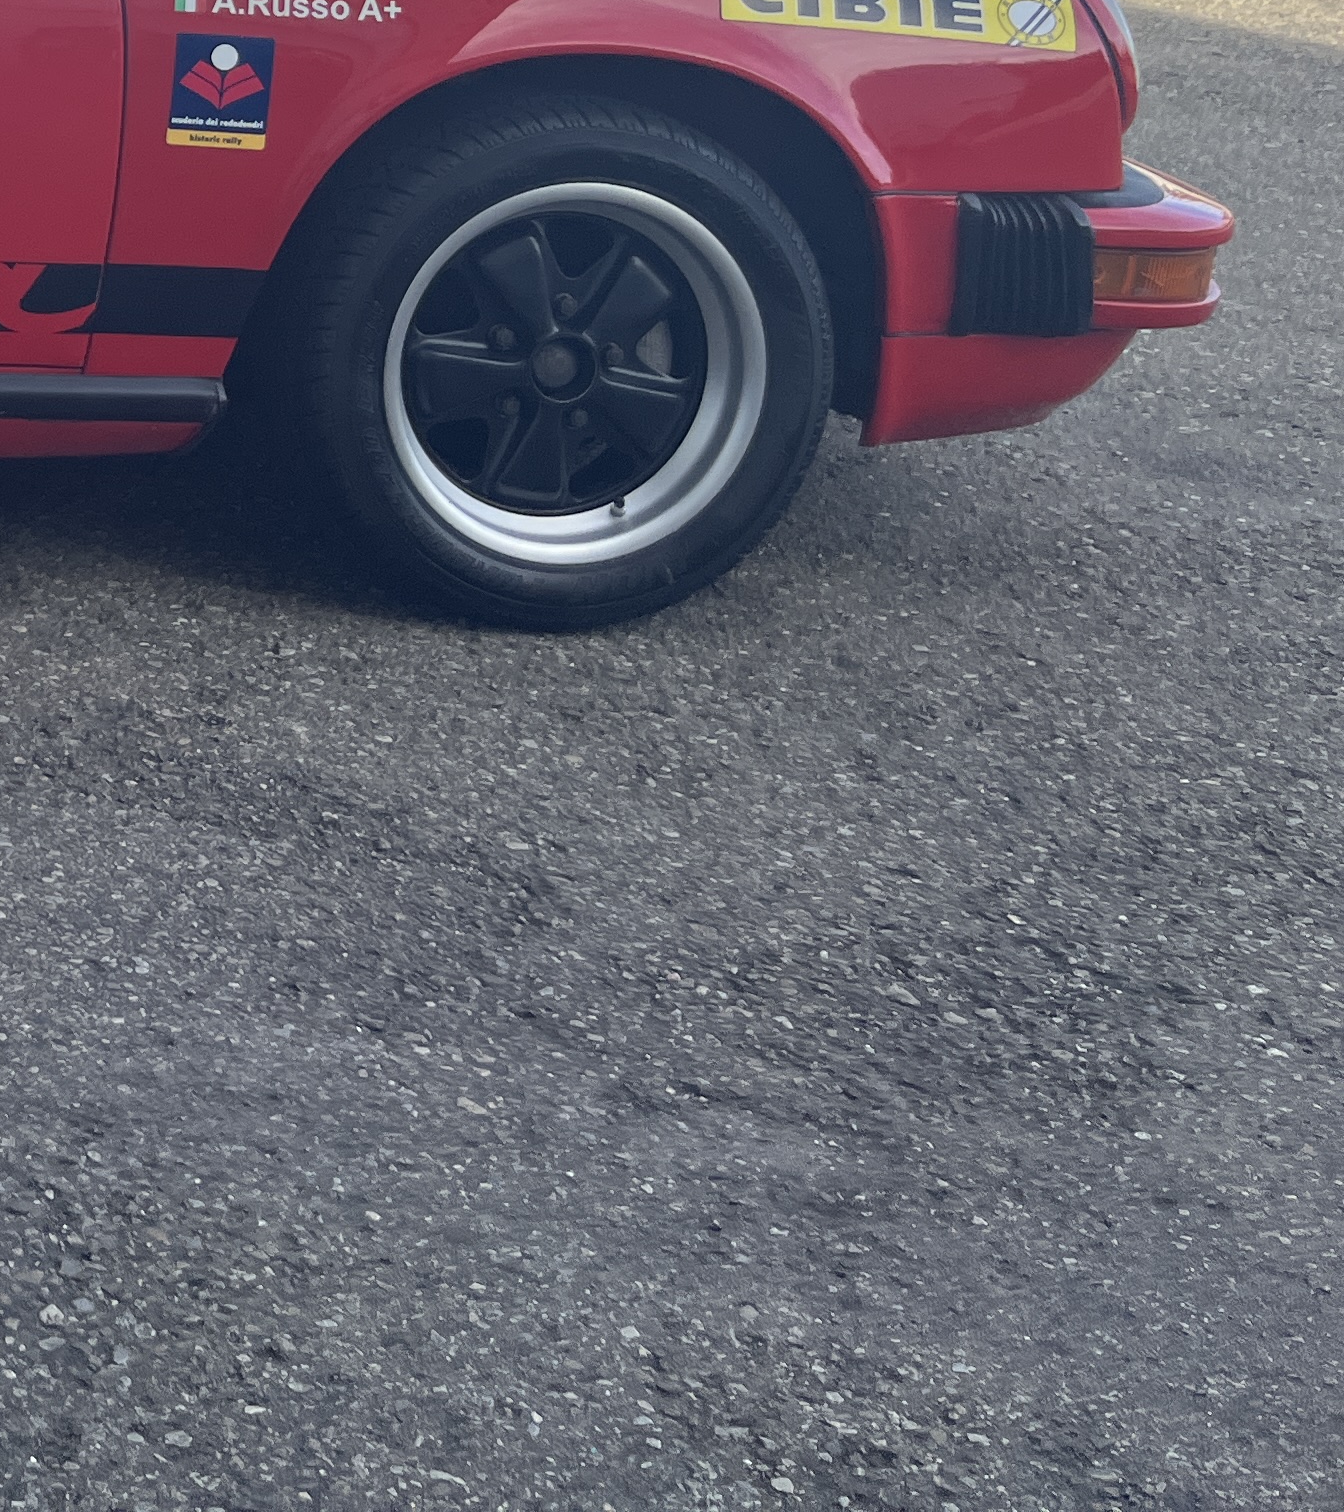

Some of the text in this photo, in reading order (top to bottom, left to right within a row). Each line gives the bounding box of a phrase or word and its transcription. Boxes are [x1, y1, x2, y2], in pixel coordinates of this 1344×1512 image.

[205, 117, 218, 127] dei
[189, 133, 242, 146] historic rally
